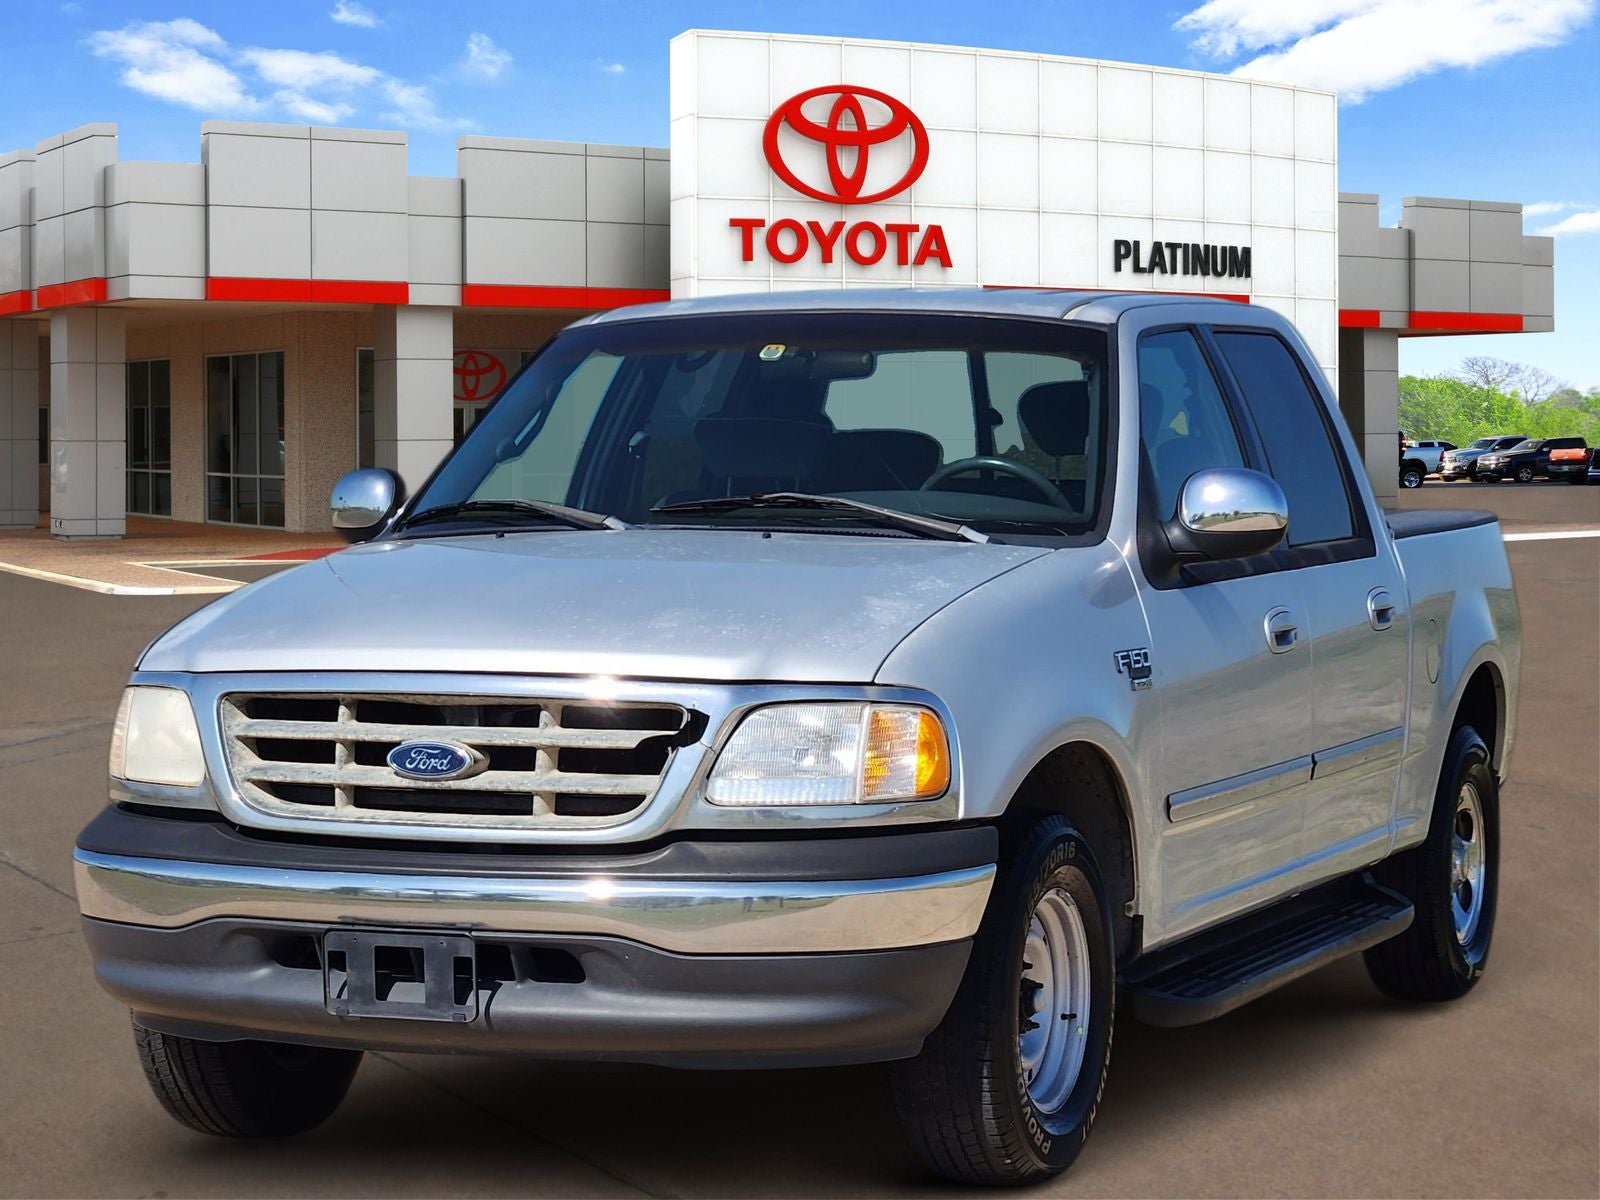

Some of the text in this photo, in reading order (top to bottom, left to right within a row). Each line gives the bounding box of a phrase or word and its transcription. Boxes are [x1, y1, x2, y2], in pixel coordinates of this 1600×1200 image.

[730, 217, 952, 268] TOYOTA
[1114, 239, 1252, 278] PLATINUM
[405, 748, 452, 770] Ford
